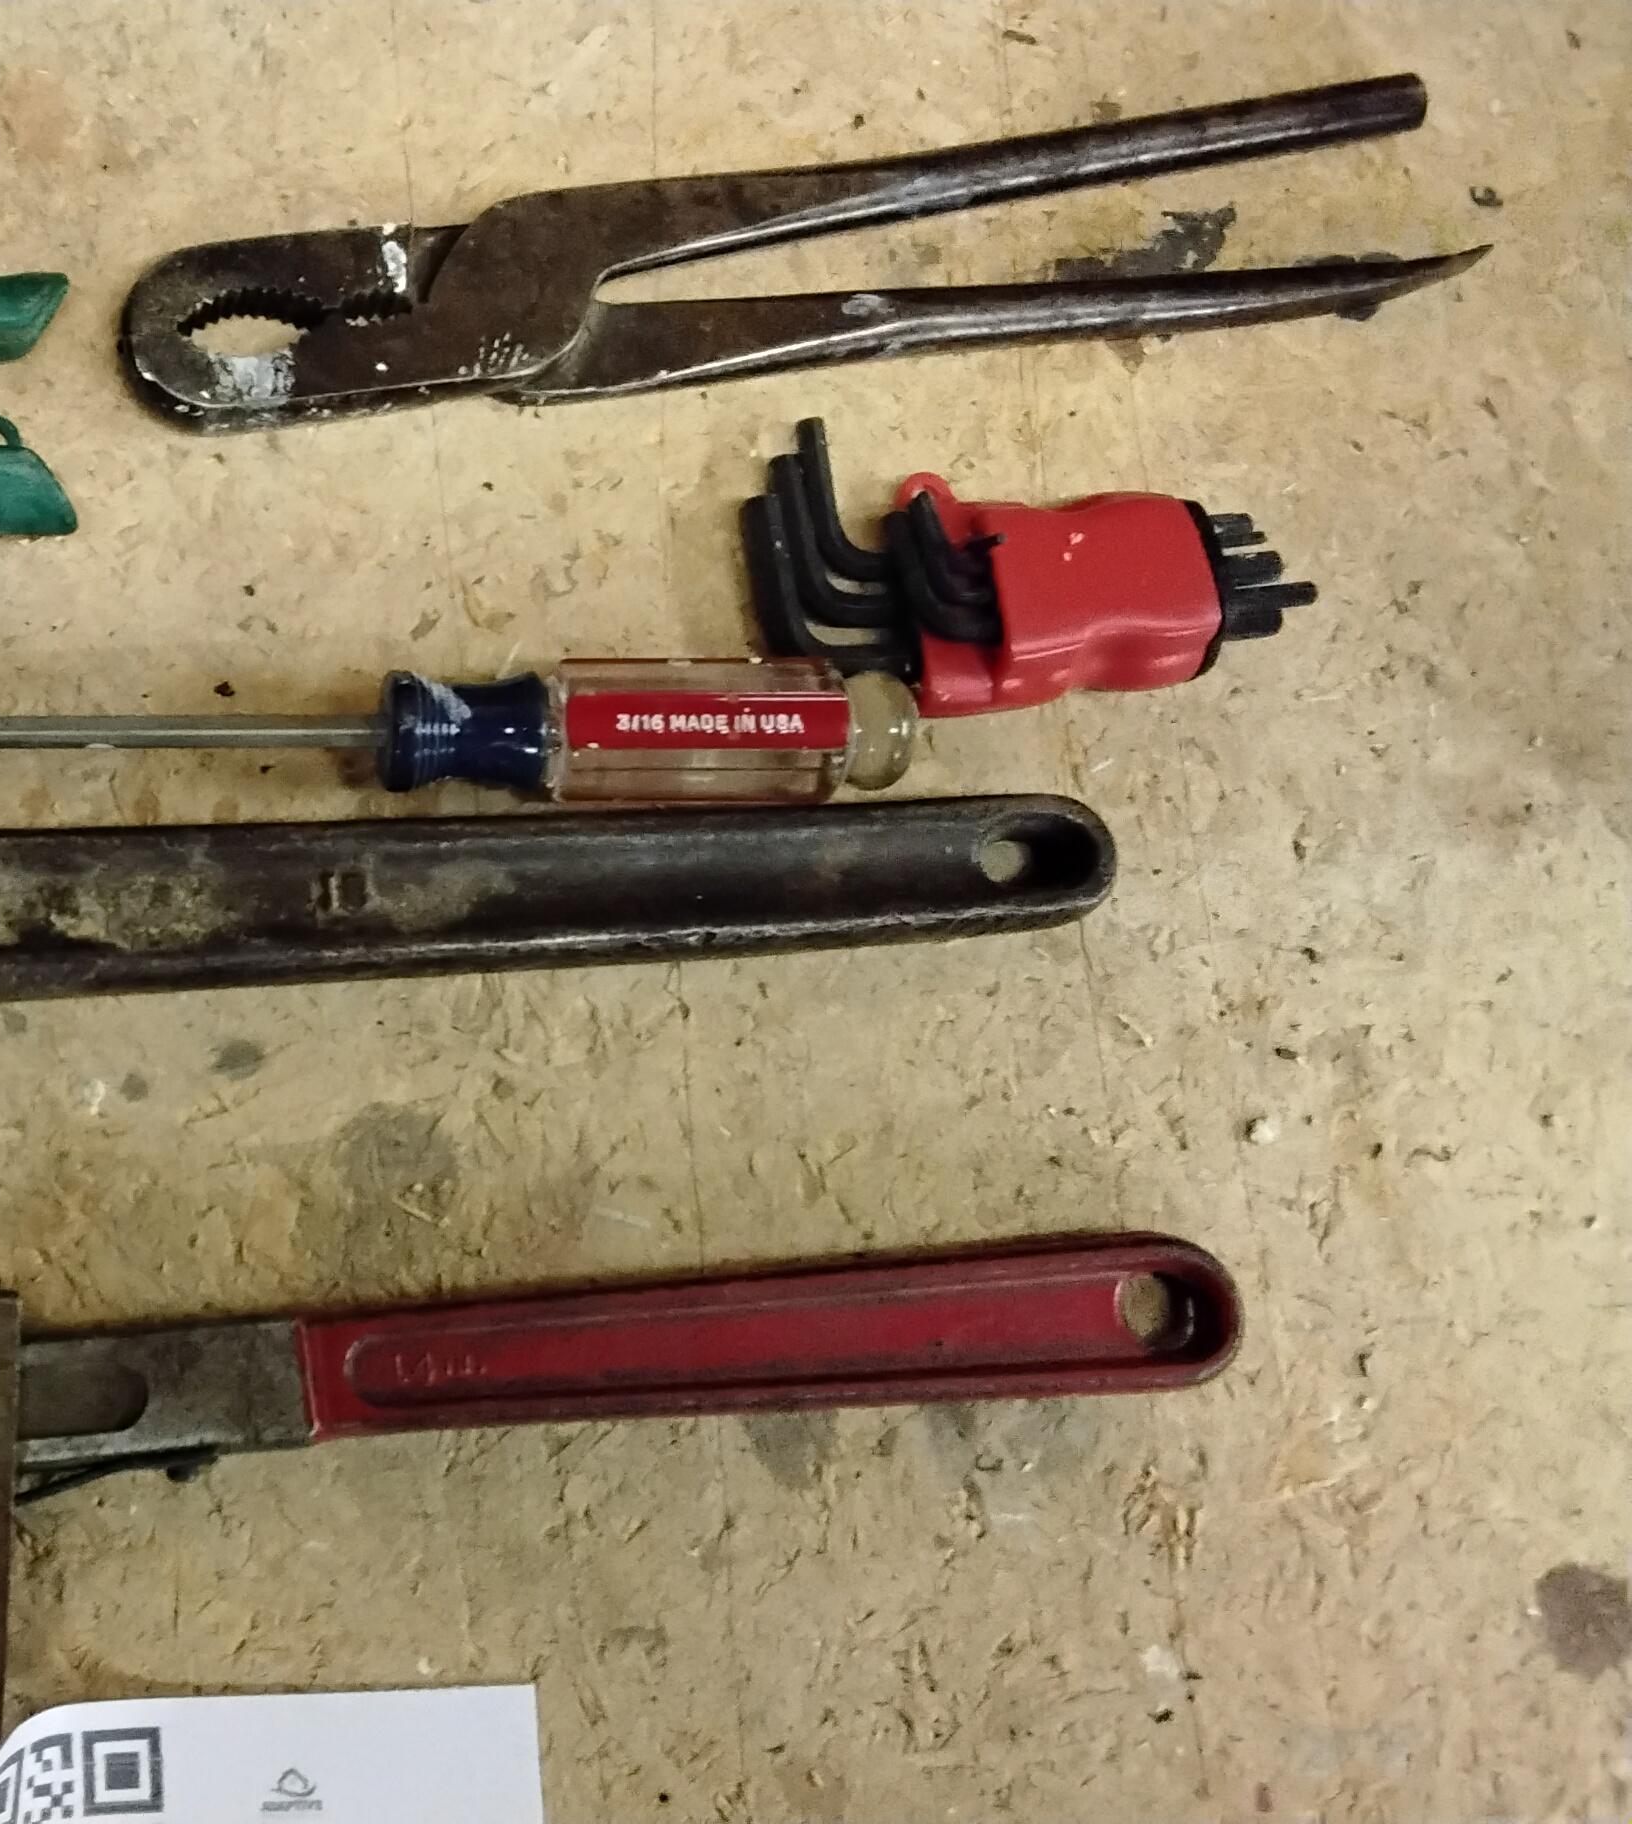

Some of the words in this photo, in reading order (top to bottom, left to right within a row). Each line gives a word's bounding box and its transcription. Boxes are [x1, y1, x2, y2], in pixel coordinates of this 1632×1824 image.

[616, 713, 666, 733] 3/16
[669, 713, 729, 734] MADE
[734, 713, 757, 733] IN
[760, 713, 805, 734] USA
